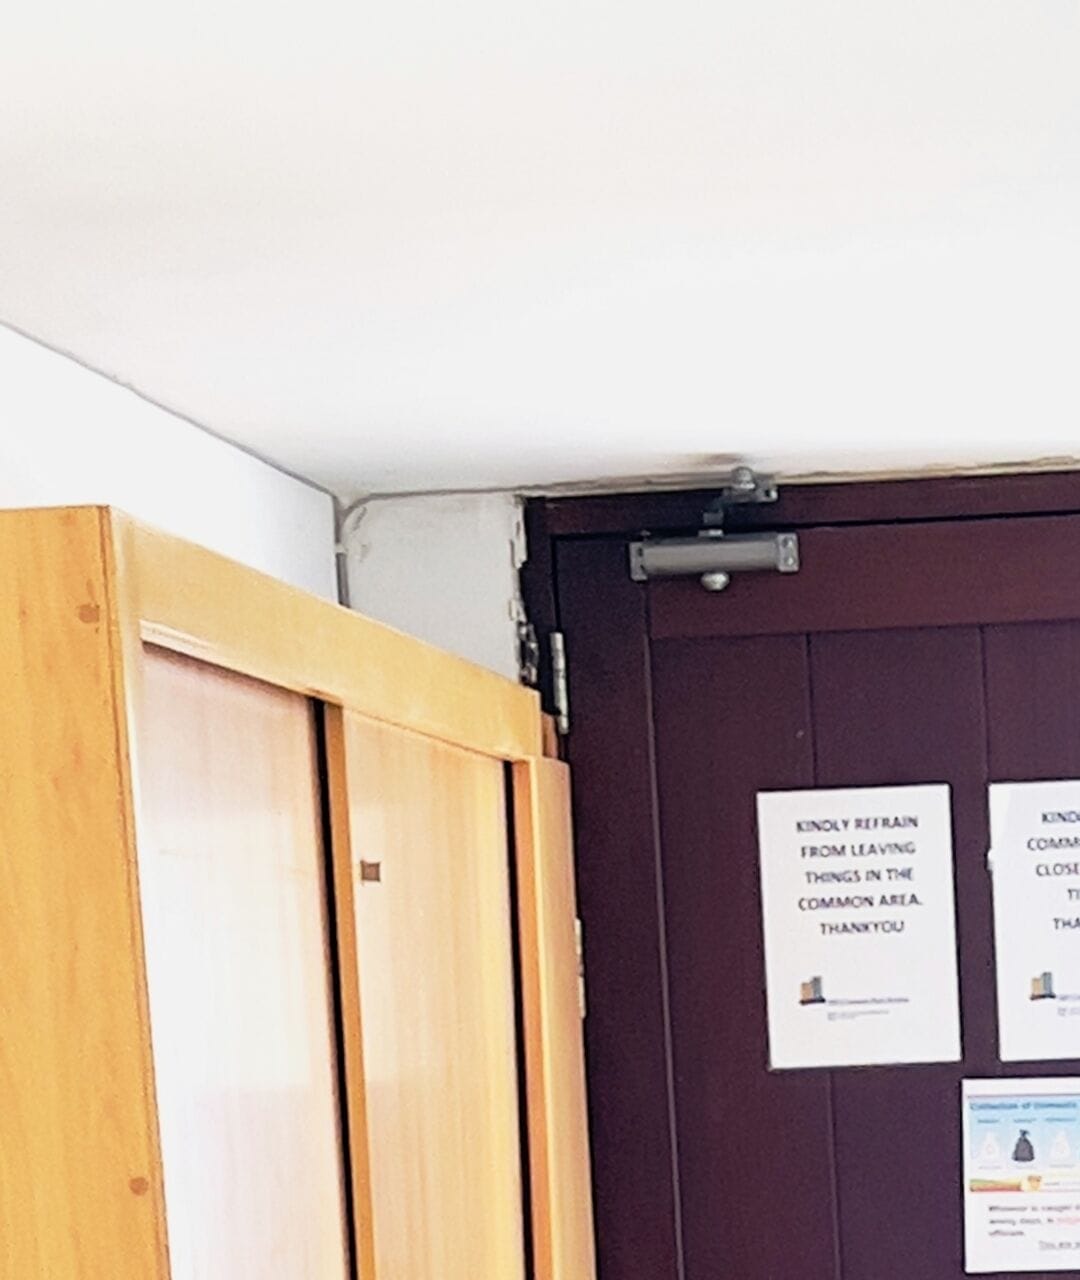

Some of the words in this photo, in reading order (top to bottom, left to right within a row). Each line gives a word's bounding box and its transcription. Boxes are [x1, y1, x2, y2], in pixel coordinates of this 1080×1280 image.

[796, 818, 850, 832] KINDLY
[854, 815, 919, 830] REFRAIN
[801, 843, 847, 858] FROM
[851, 840, 917, 857] LEAVING
[805, 869, 861, 884] THINGS
[865, 869, 881, 881] IN
[885, 866, 914, 881] THE
[798, 895, 874, 911] COMMON
[879, 892, 923, 907] AREA.
[820, 919, 905, 935] THANKYOU
